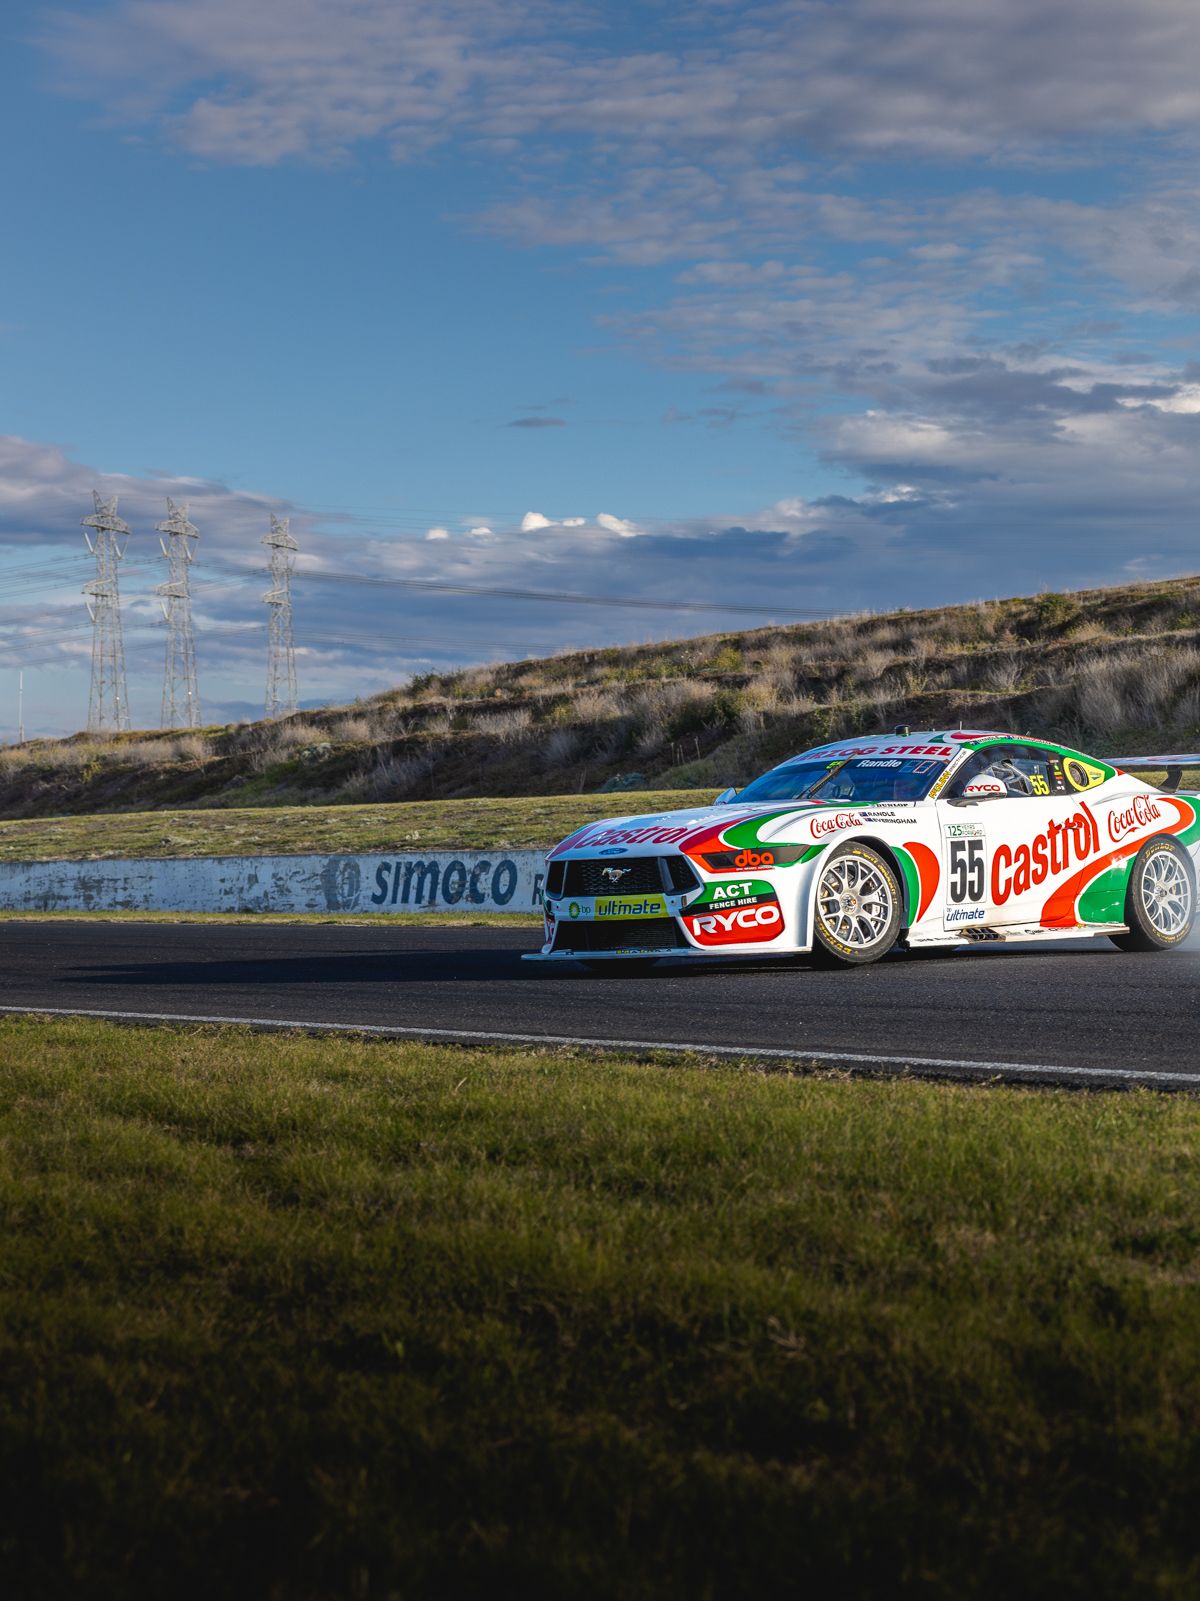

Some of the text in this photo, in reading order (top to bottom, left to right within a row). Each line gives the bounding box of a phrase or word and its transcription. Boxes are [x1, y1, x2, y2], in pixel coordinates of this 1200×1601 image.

[881, 746, 954, 757] STEEL
[856, 759, 902, 768] Randle
[964, 784, 1001, 792] RYCO
[1029, 775, 1050, 795] 55
[810, 813, 862, 839] Coca-Cola
[1107, 795, 1161, 843] Coca-Cola
[573, 826, 705, 849] Castrol
[948, 825, 962, 836] 125
[735, 849, 775, 867] dba
[991, 800, 1100, 906] Castrol
[950, 840, 985, 903] 55
[713, 882, 753, 900] ACT
[581, 899, 661, 917] bp ultimate
[709, 897, 758, 910] FENCE HIRE
[692, 906, 780, 936] RYCO
[946, 907, 985, 921] ultimate
